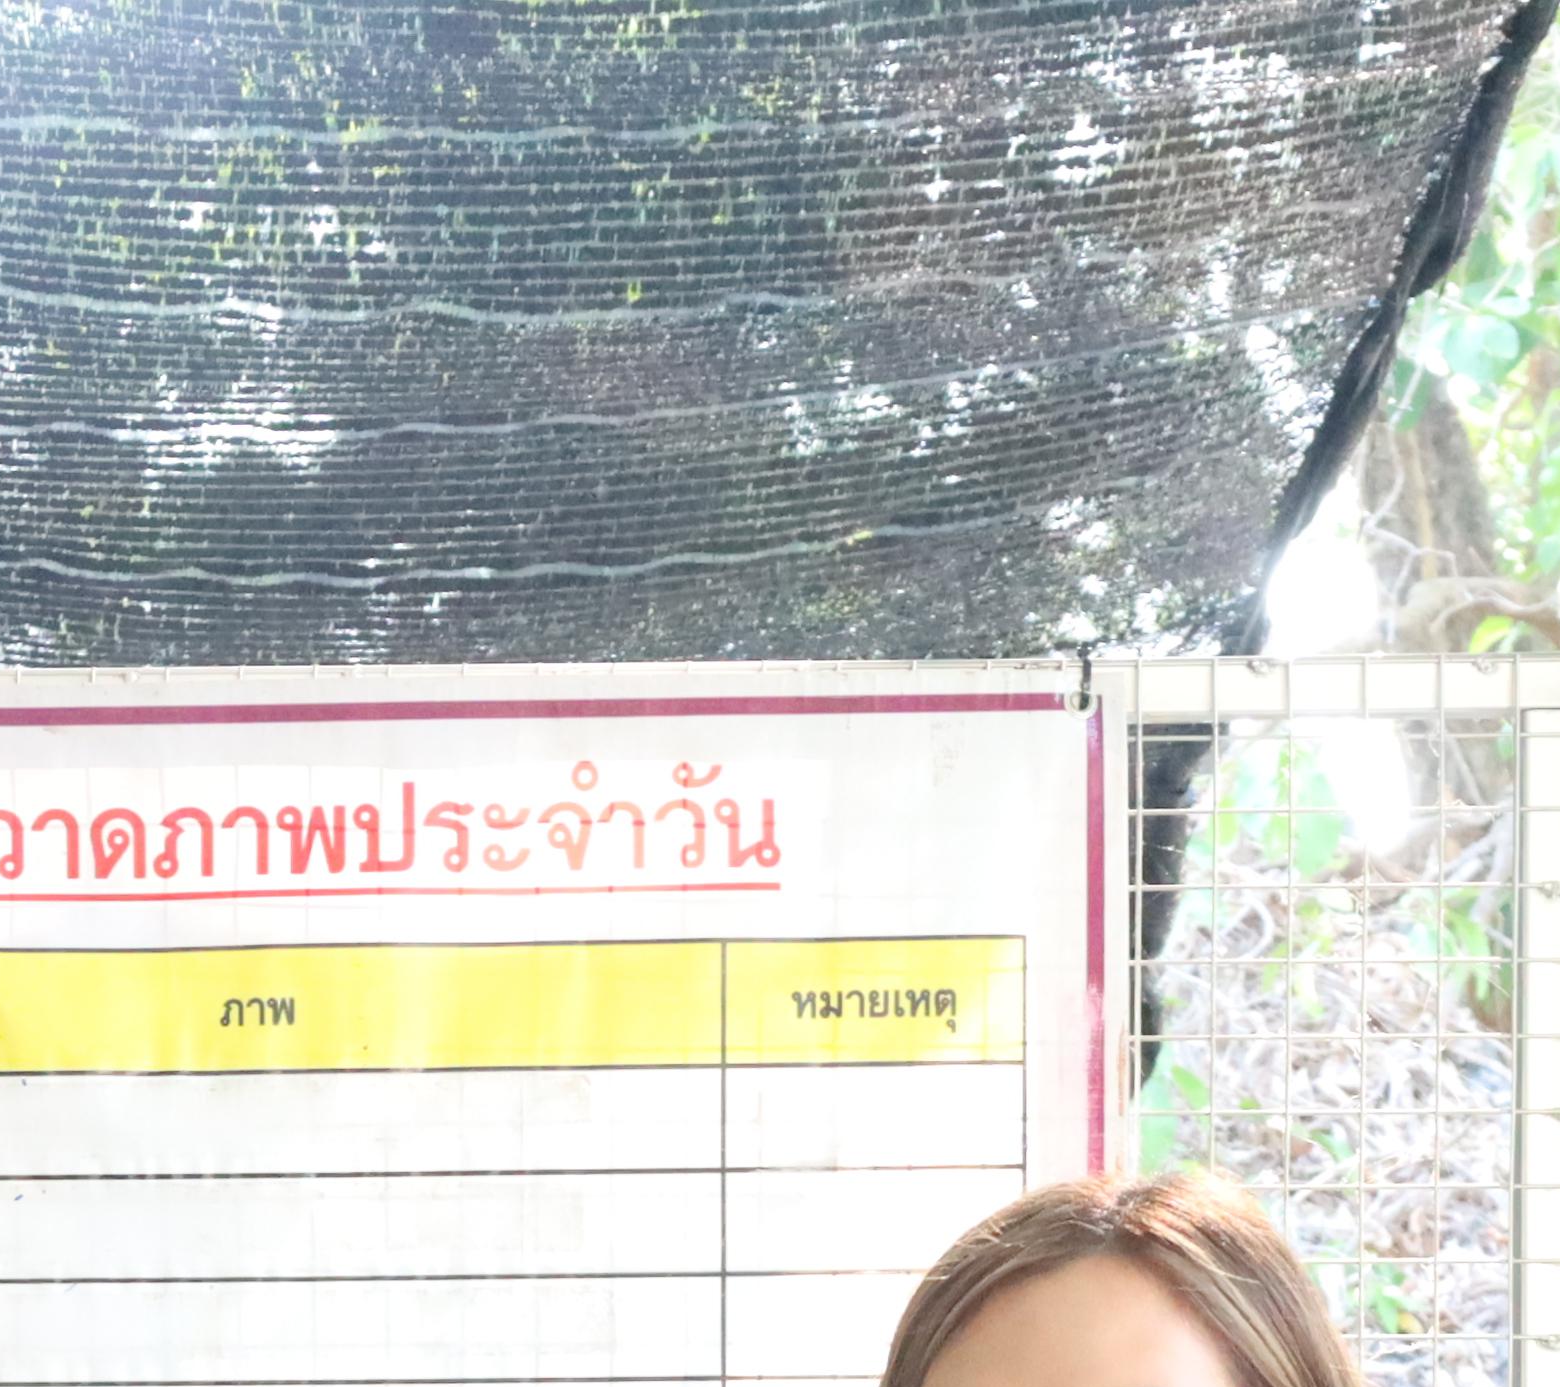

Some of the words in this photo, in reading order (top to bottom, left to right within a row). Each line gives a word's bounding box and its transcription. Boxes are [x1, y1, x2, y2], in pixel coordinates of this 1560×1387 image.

[219, 997, 295, 1028] ภาพ
[791, 988, 957, 1033] หมายเหตุ
